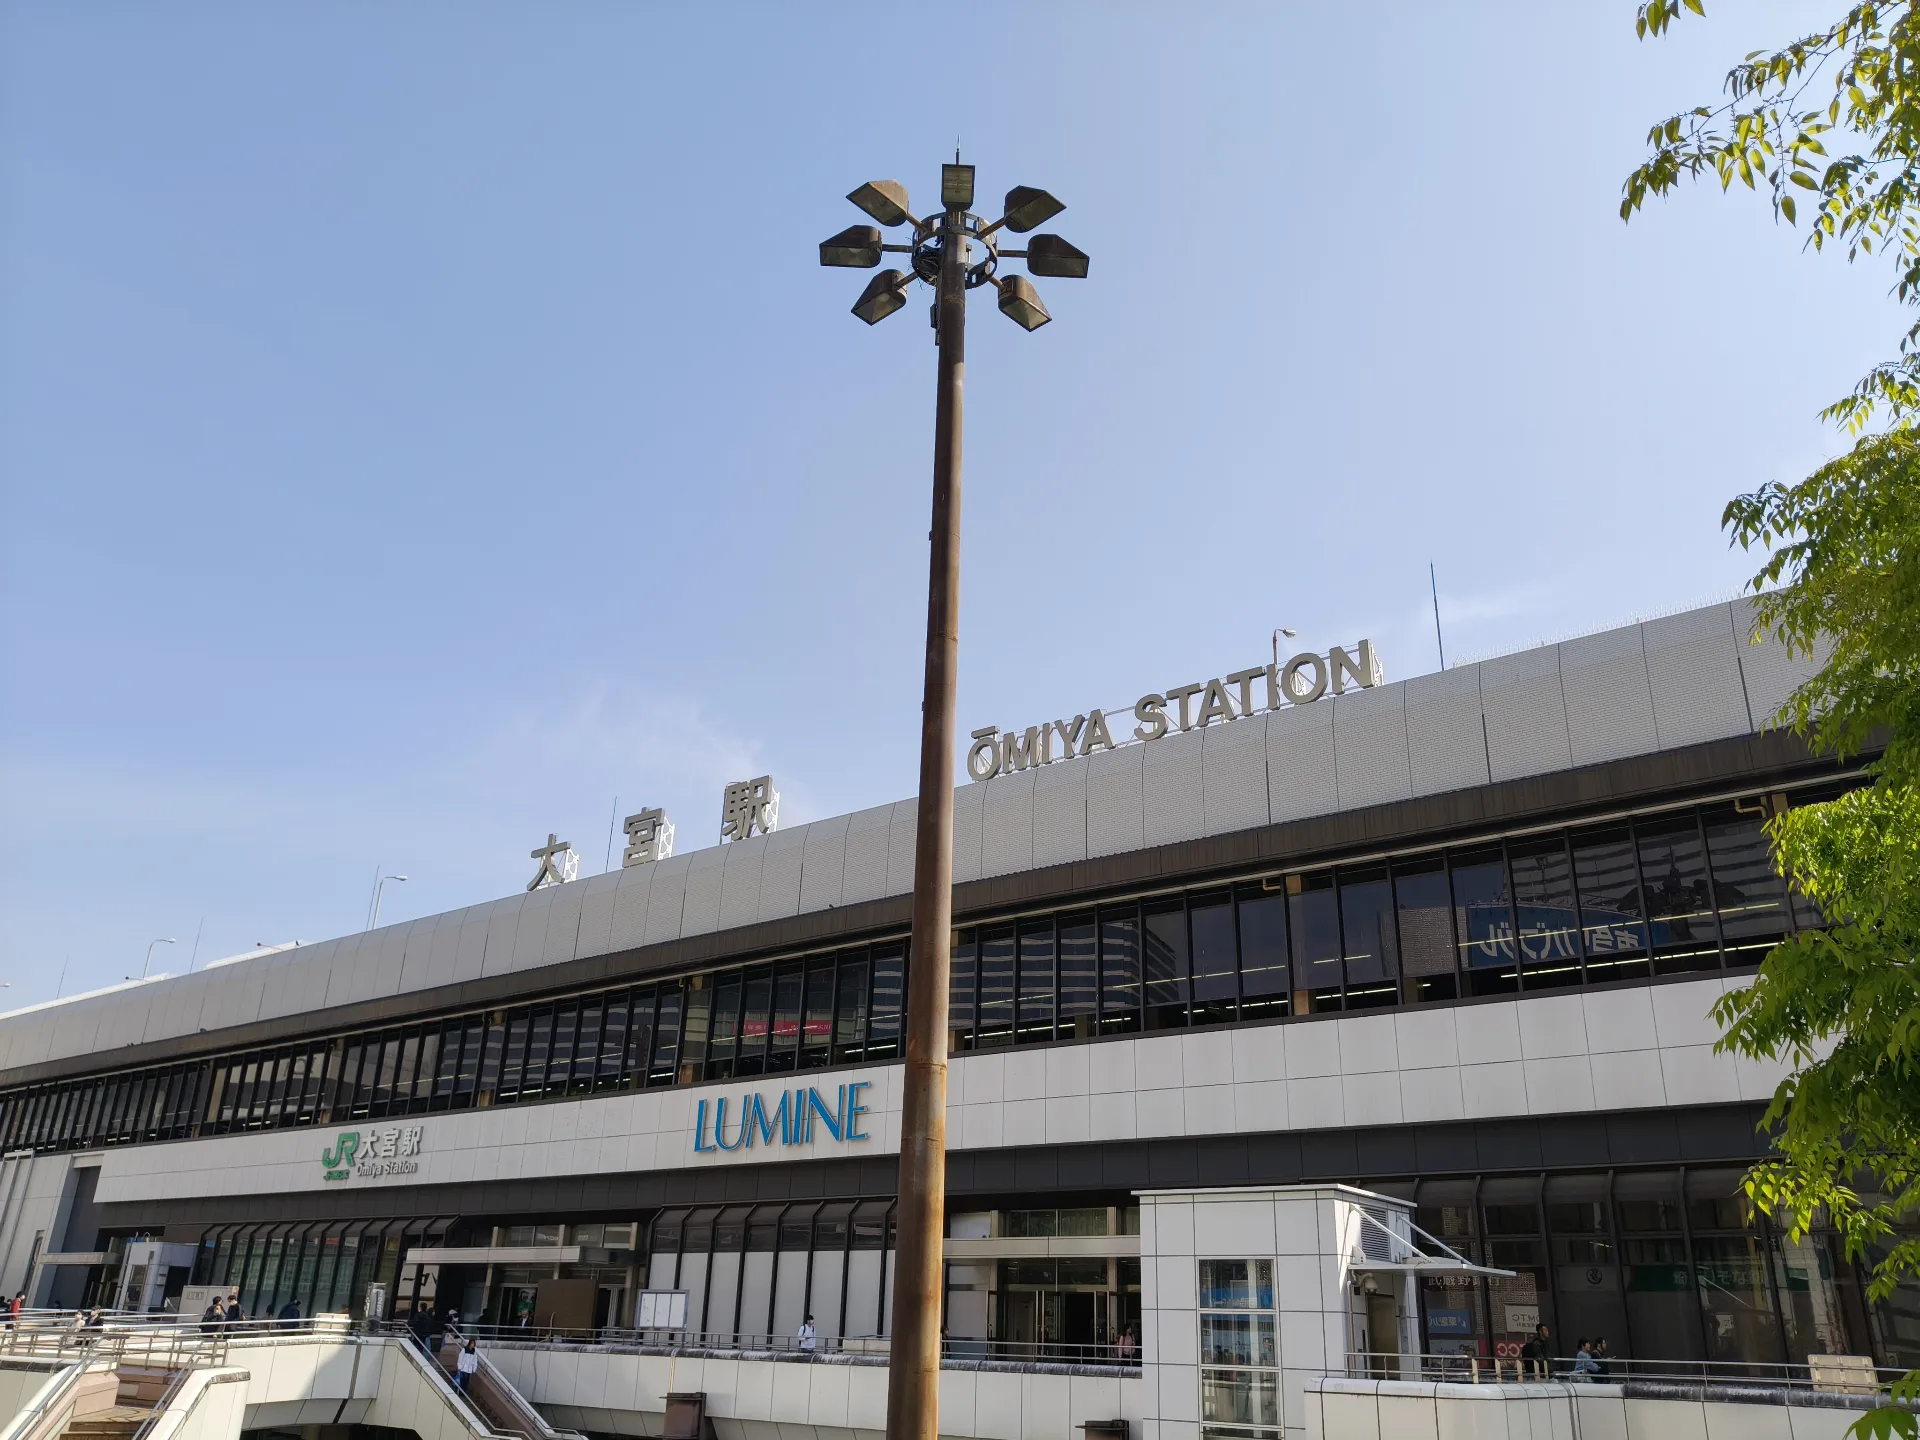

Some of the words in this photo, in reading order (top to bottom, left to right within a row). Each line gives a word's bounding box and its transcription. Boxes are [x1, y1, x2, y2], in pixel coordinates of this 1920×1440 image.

[1134, 639, 1375, 741] STATION
[527, 774, 773, 892] 大宮駅
[359, 1126, 424, 1160] 大宮駅
[694, 1081, 872, 1152] LUMINE
[322, 1132, 360, 1168] JR
[356, 1163, 384, 1178] Omiya
[385, 1161, 418, 1175] Station
